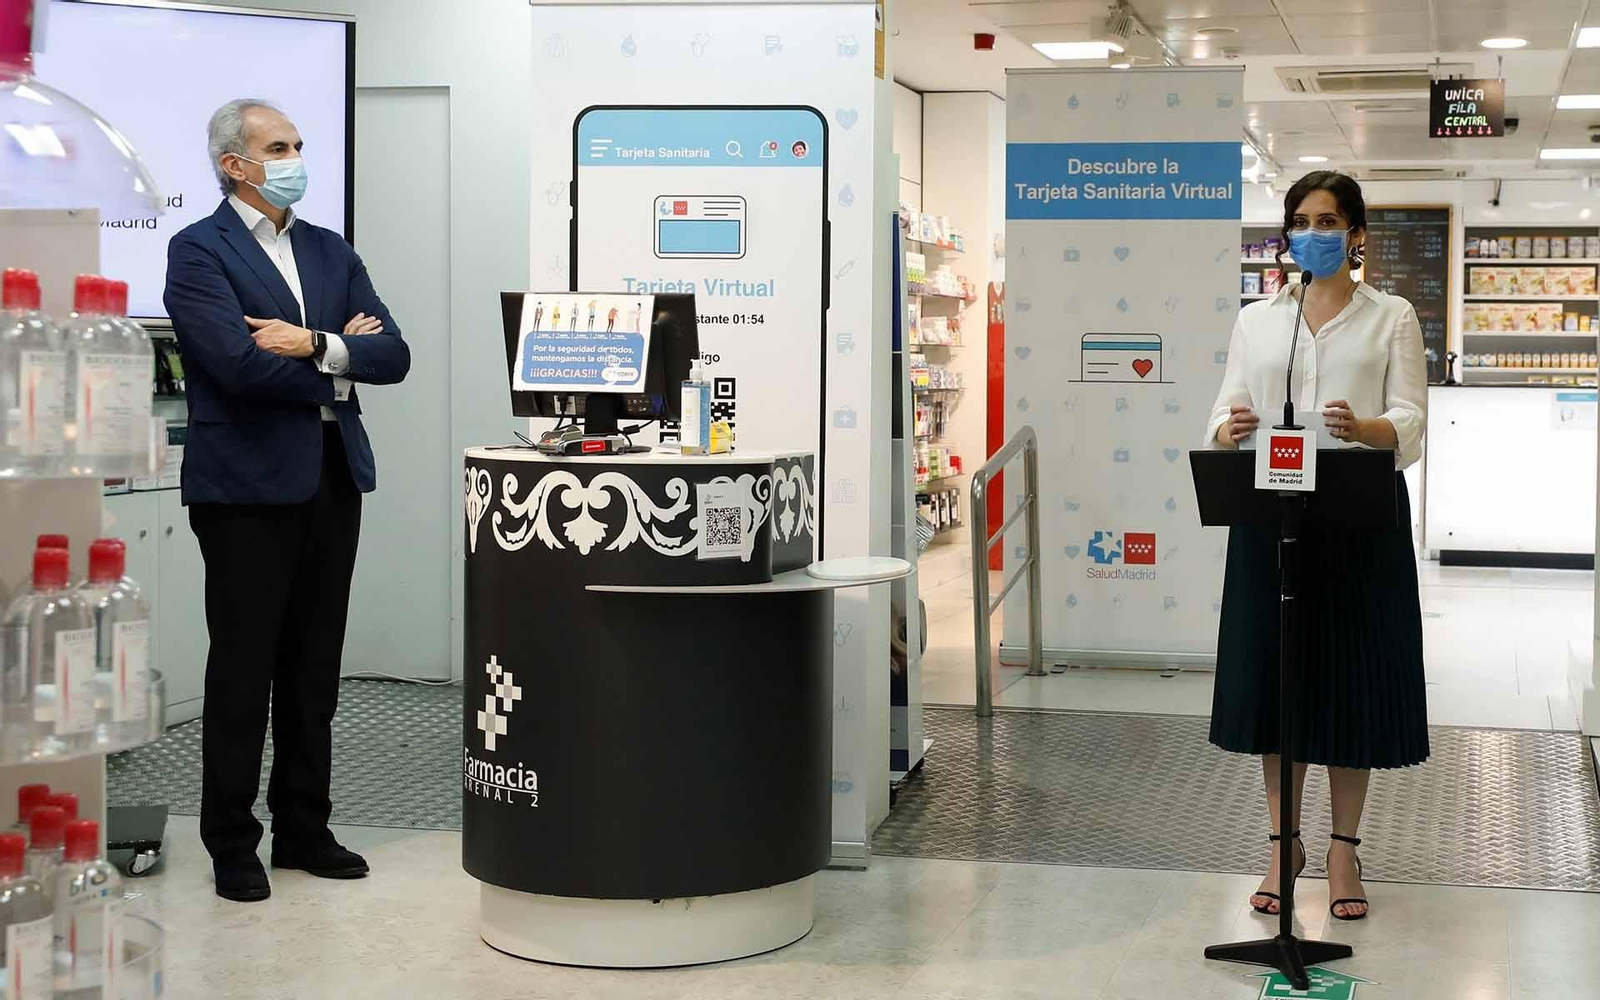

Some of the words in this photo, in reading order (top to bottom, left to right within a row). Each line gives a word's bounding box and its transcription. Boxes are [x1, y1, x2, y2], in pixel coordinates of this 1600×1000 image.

[1444, 115, 1488, 127] CENTRAL
[614, 147, 655, 160] Tarjeta
[658, 147, 710, 159] Sanitaria
[1067, 158, 1157, 175] Descubre
[1163, 158, 1179, 175] la
[1014, 183, 1078, 204] Tarjeta
[1083, 182, 1166, 200] Sanitaria
[1171, 182, 1233, 200] Virtual
[623, 277, 695, 295] Tarjeta
[704, 278, 774, 297] Virtual
[695, 315, 730, 325] stante
[733, 314, 764, 325] 01:54
[533, 344, 547, 352] Por
[549, 344, 556, 352] la
[558, 345, 596, 354] seguridad
[532, 355, 586, 363] mantengamos
[587, 355, 595, 363] la
[701, 352, 720, 365] igo
[464, 746, 538, 791] Farmacia
[464, 776, 514, 804] ARENAL
[530, 794, 539, 807] 2
